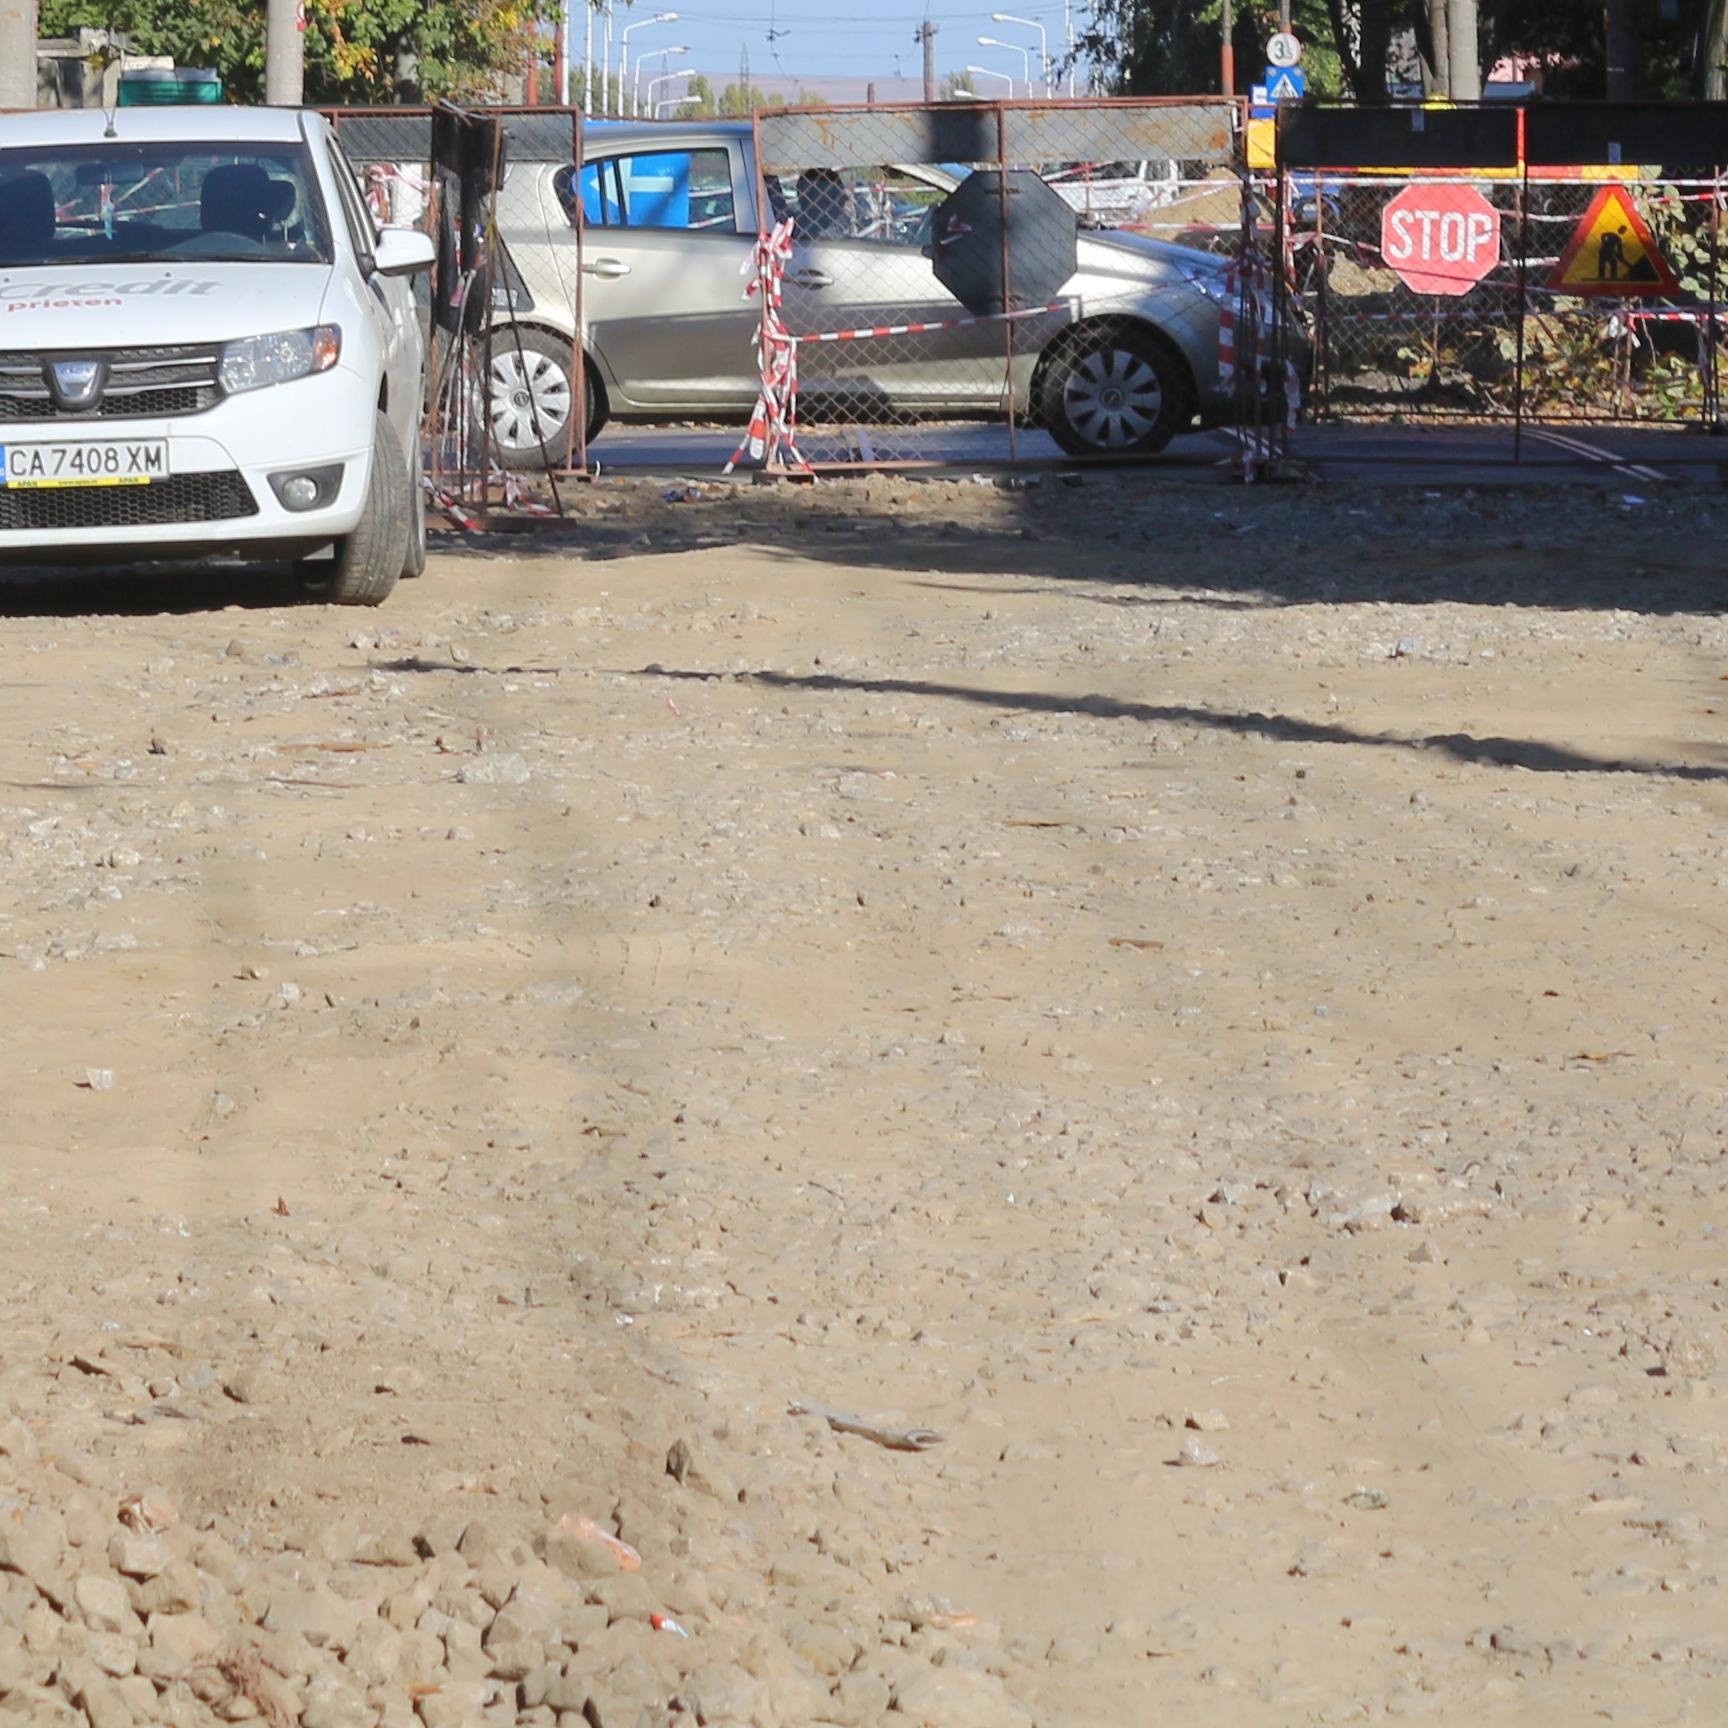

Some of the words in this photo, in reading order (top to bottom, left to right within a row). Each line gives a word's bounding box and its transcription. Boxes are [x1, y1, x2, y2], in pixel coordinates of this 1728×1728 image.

[1389, 209, 1492, 262] STOP
[8, 298, 123, 313] prieten
[10, 449, 45, 476] CA
[52, 447, 120, 475] 7408
[126, 445, 162, 472] XM
